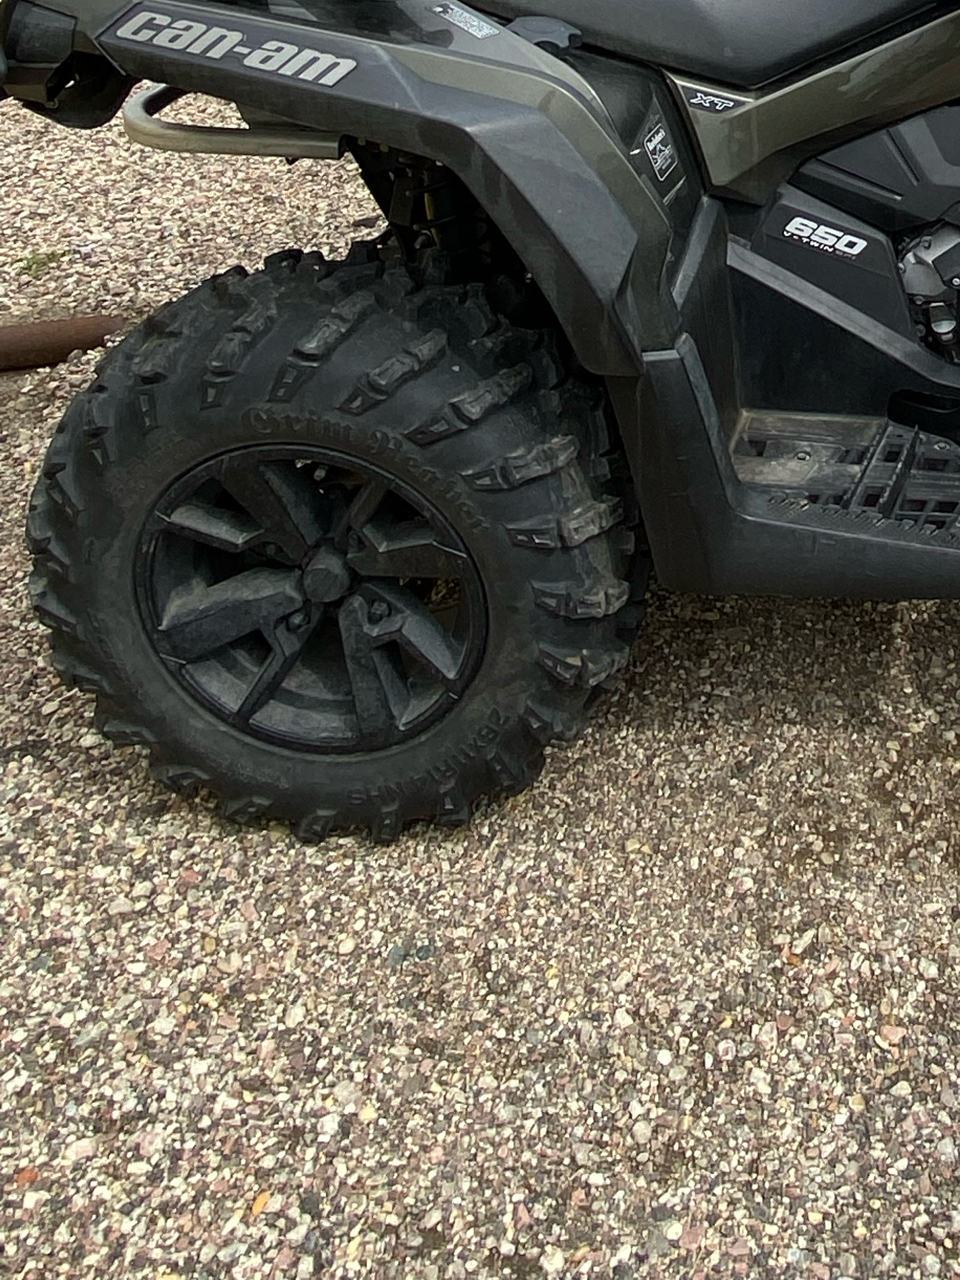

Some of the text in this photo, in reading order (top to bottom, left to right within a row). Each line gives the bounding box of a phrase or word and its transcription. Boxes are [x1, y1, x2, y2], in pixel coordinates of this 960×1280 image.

[116, 11, 357, 87] can-am
[690, 92, 735, 110] XT
[783, 230, 834, 252] V-TWIN
[784, 216, 868, 255] 650
